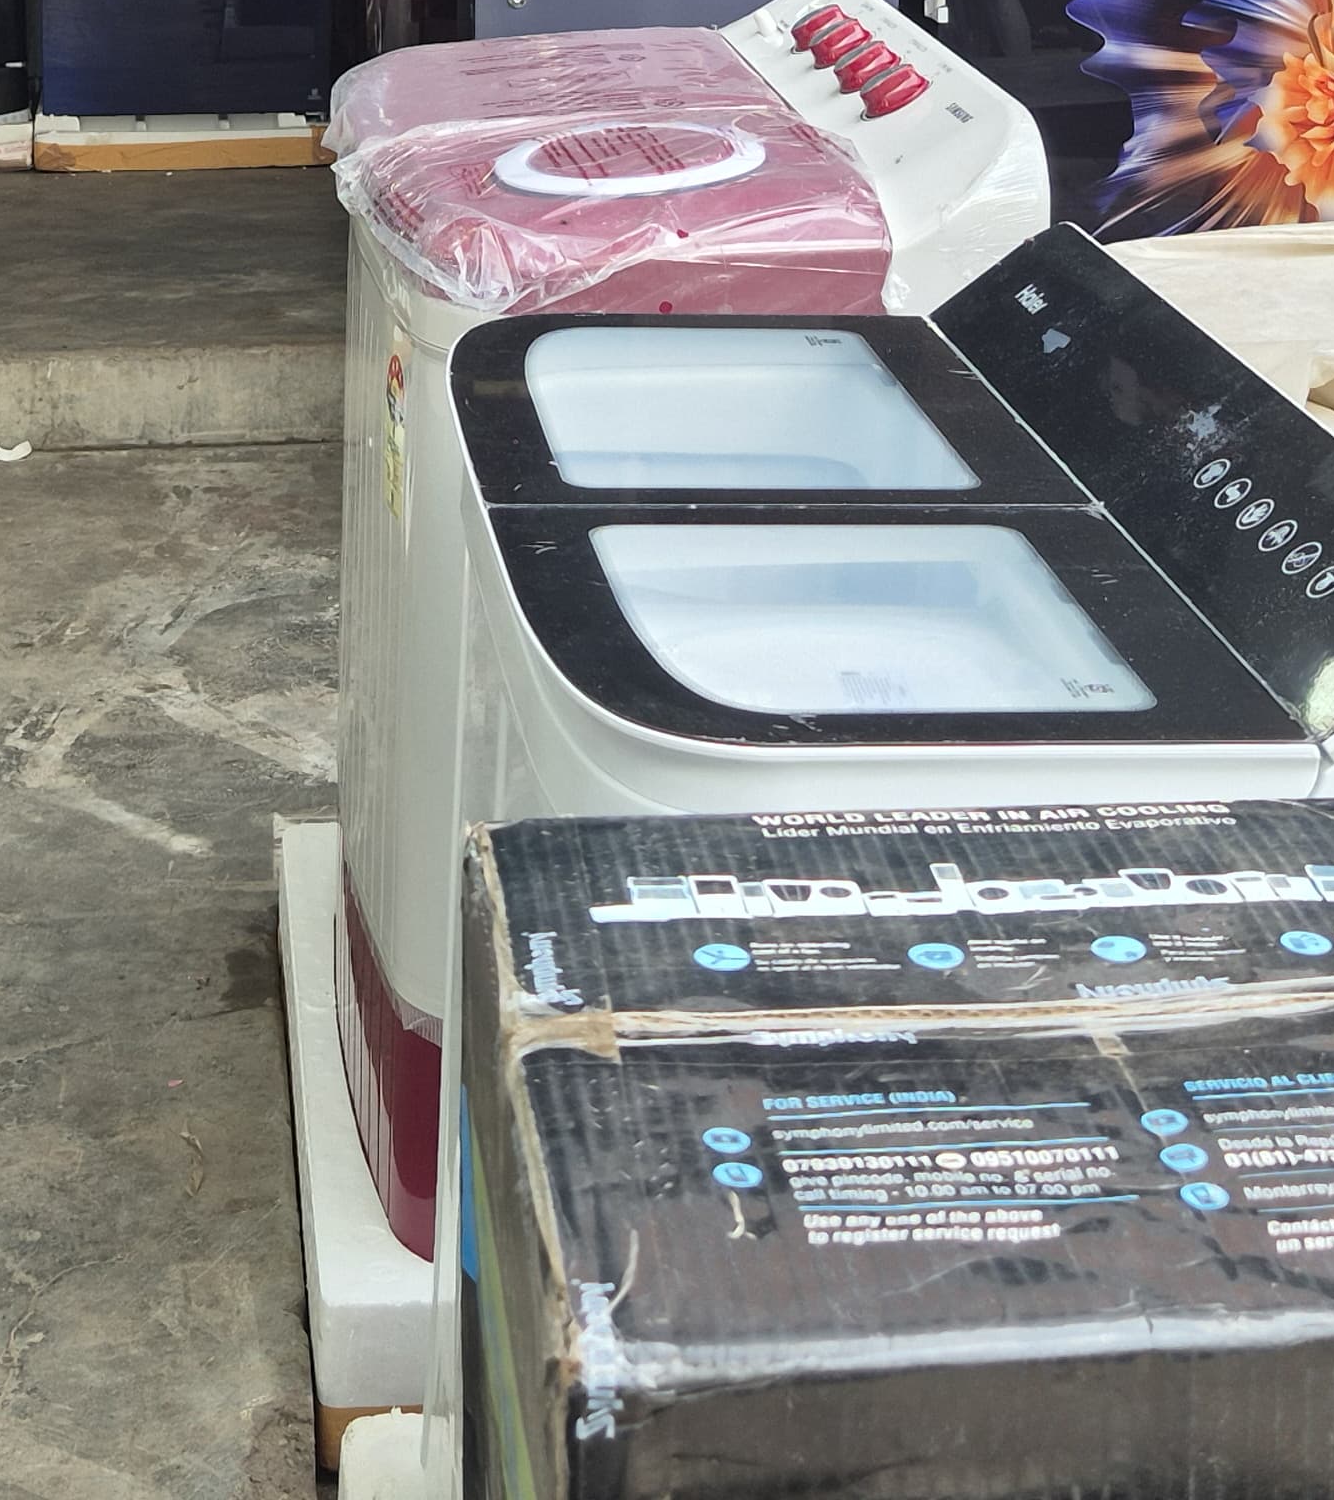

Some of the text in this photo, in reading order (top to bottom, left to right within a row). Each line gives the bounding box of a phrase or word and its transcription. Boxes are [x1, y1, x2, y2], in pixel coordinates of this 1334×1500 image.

[1015, 284, 1049, 316] Haier
[752, 802, 1231, 827] WORLD LEADER IN AIR COOLING
[761, 814, 1237, 840] Líder Mundial en Enfriamiento Evaporativo
[762, 1097, 803, 1110] FOR
[805, 1093, 886, 1109] SERVICE
[913, 1170, 976, 1184] mobile
[1034, 1167, 1084, 1183] serial
[828, 1187, 889, 1203] timing
[803, 1213, 842, 1229] Use
[845, 1213, 882, 1230] any
[884, 1212, 922, 1226] one
[948, 1210, 982, 1224] the
[984, 1208, 1043, 1224] above
[807, 1222, 1061, 1246] to register service request
